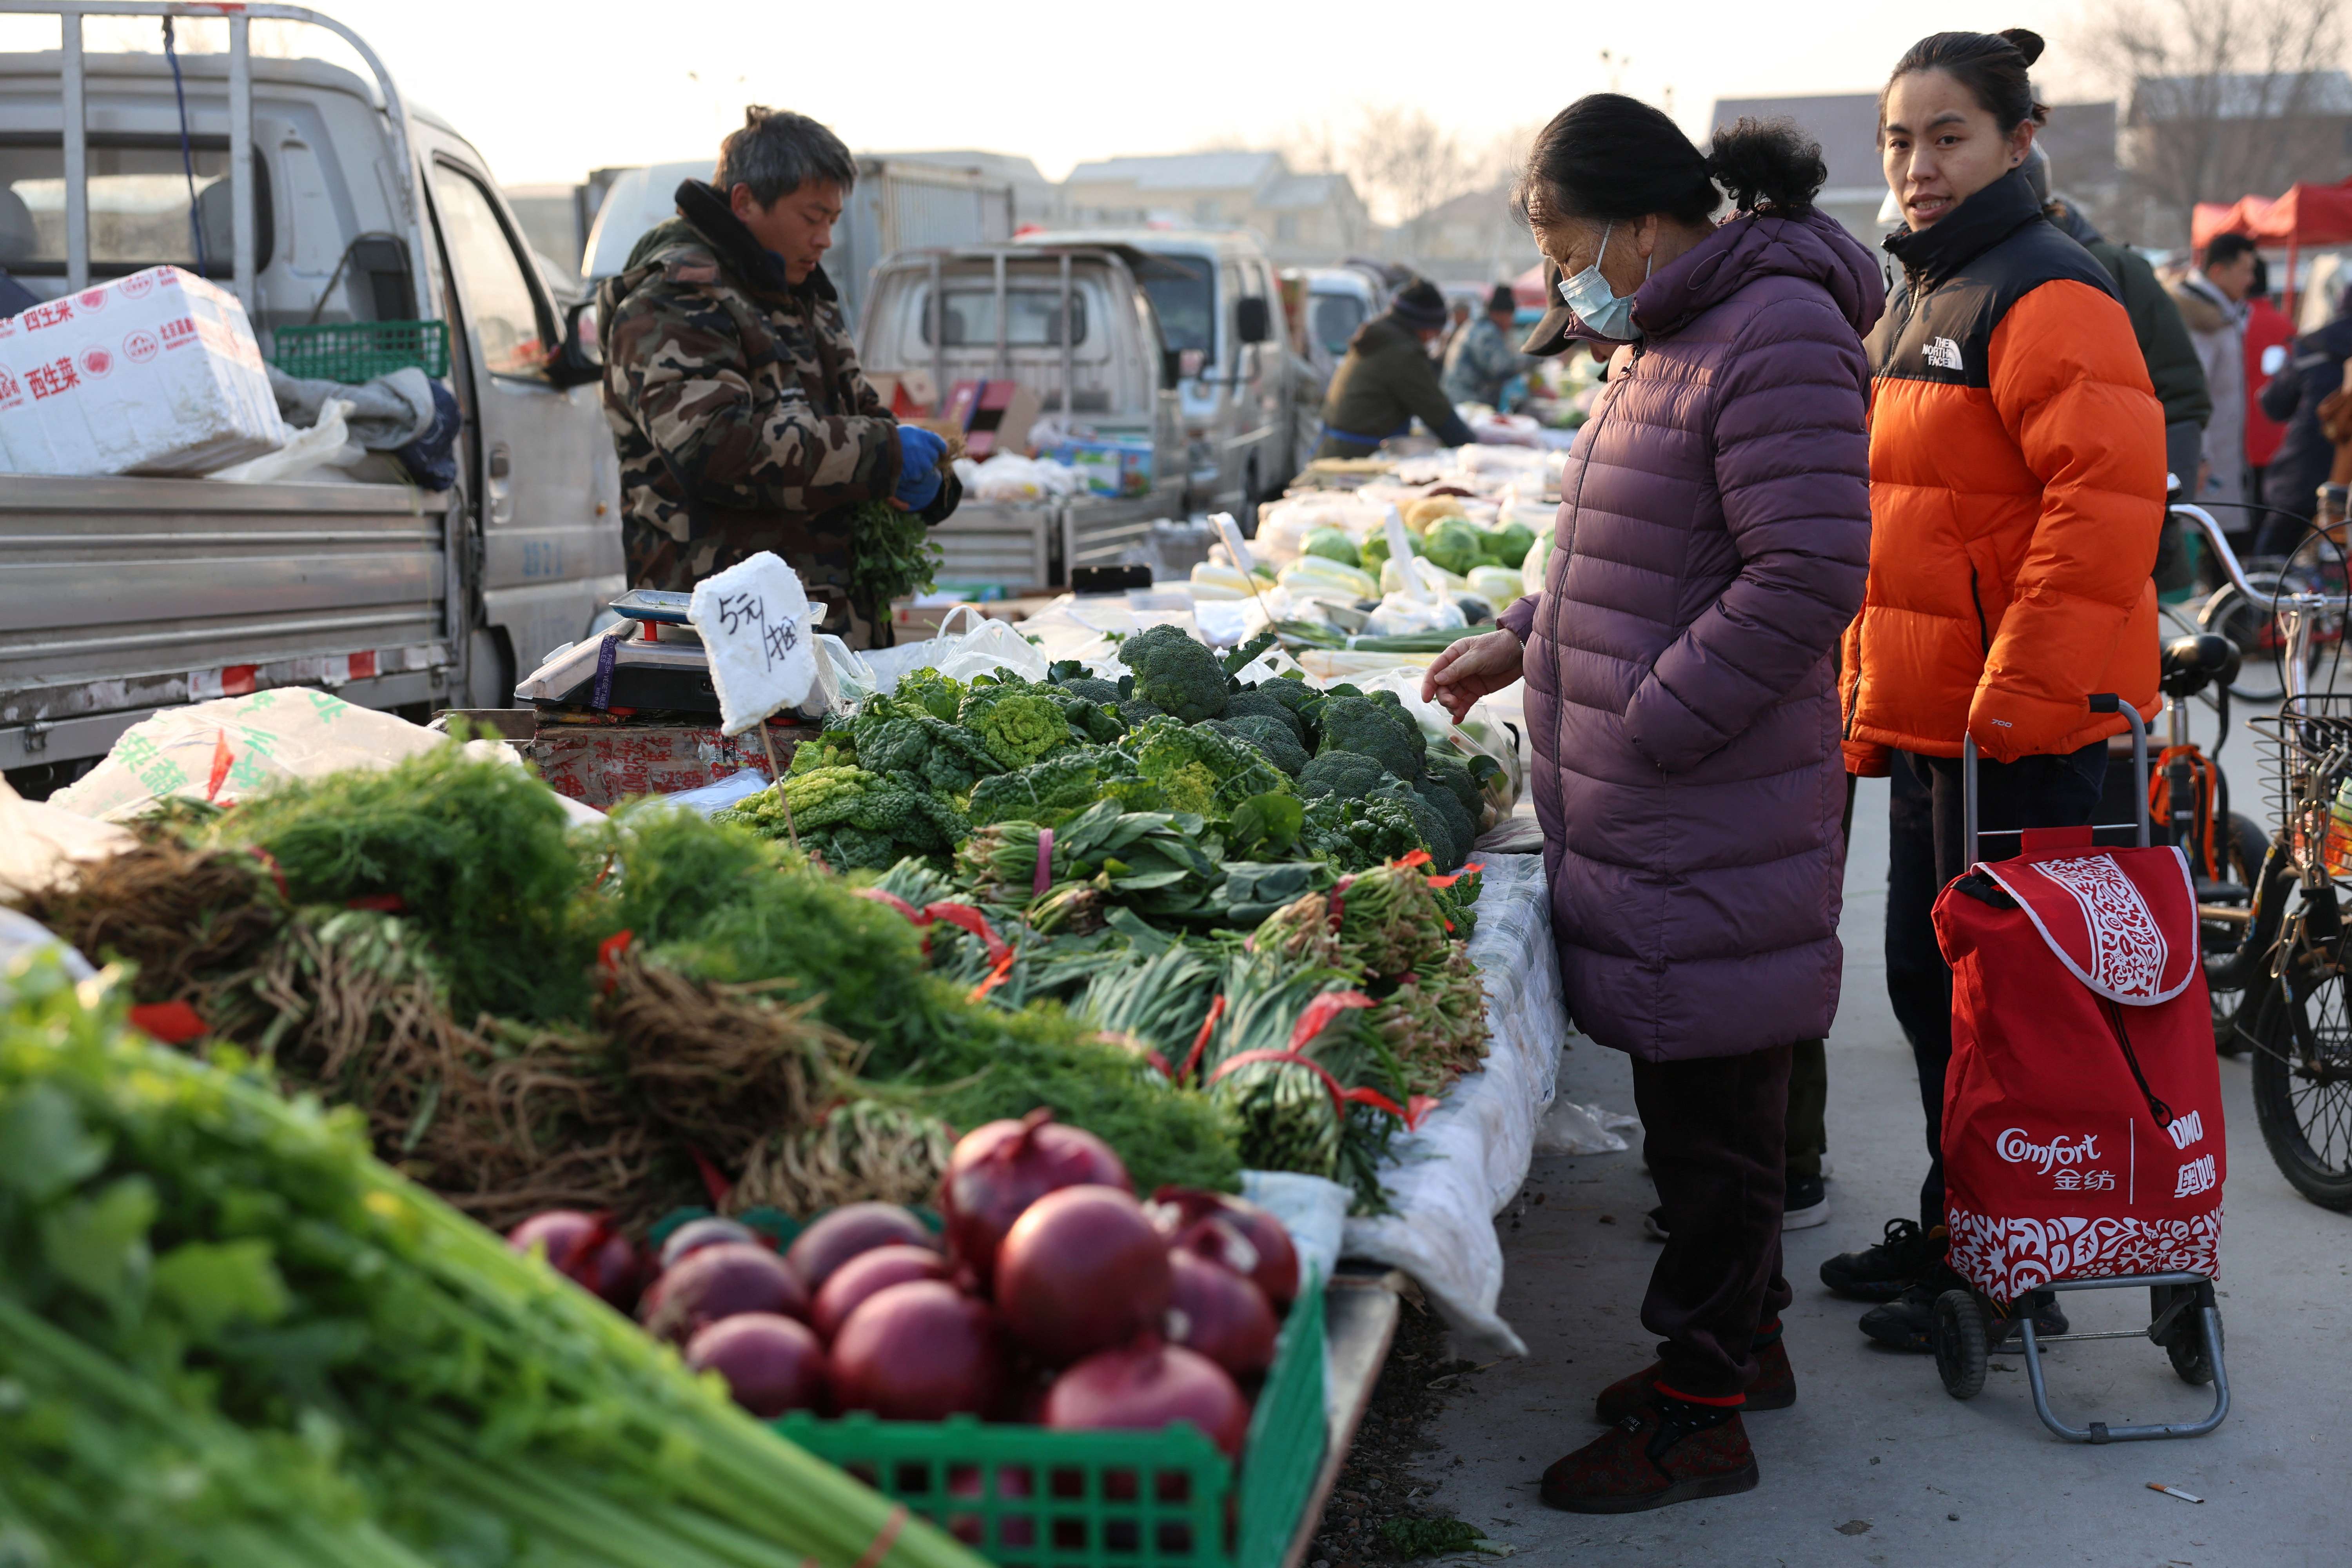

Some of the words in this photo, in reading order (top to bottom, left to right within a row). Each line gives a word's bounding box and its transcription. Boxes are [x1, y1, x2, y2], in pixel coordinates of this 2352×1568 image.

[1921, 343, 1950, 358] NORTH
[1935, 336, 1950, 347] THE
[24, 356, 80, 399] 西生菜
[1928, 356, 1951, 367] FACE
[599, 675, 609, 710] VEGETABLES
[2167, 1110, 2203, 1150] OMO
[1996, 1127, 2101, 1176] Comfort
[2053, 1169, 2116, 1191] 金纺
[2174, 1153, 2216, 1198] 奥妙
